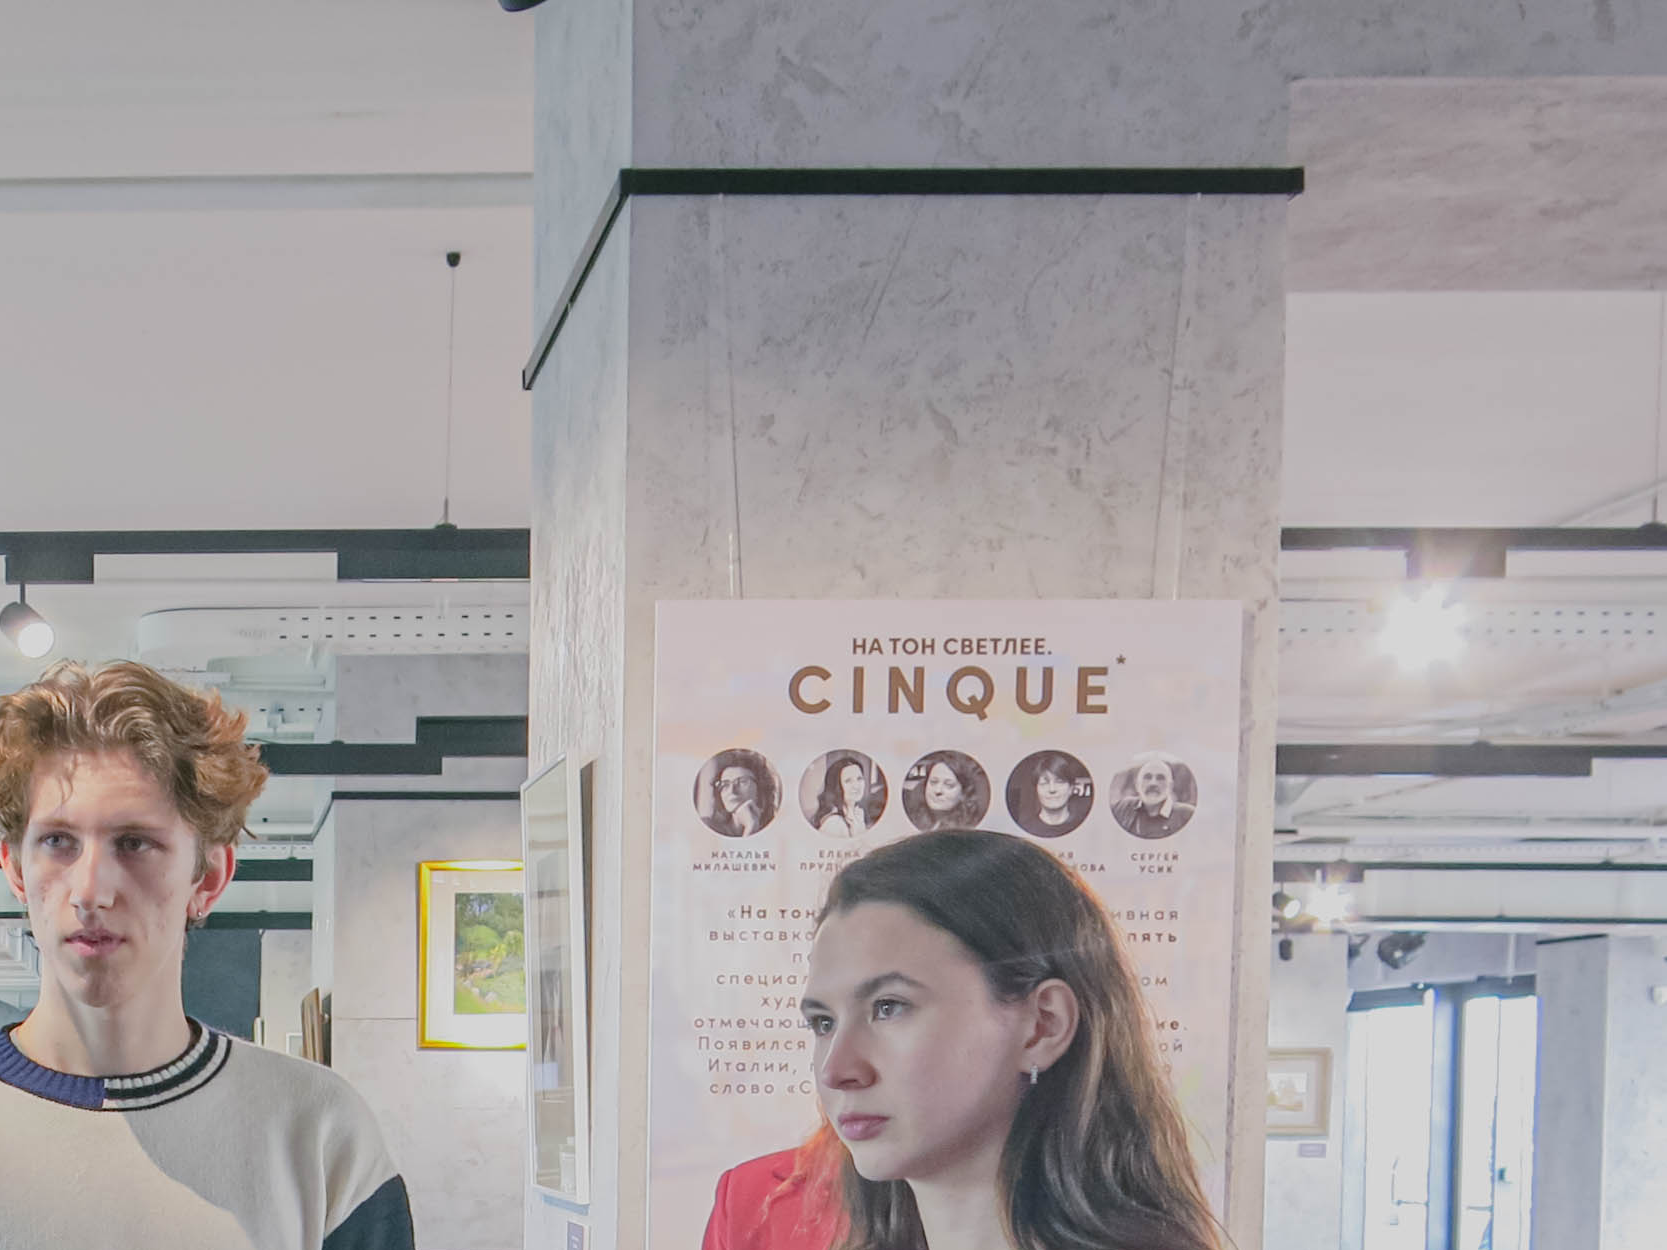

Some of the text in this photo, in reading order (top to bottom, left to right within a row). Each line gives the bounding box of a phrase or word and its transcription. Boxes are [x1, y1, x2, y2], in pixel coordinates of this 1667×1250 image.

[852, 637, 1053, 656] НА ТОН СВЕТЛЕЕ.
[787, 665, 1110, 722] CINQUE
[711, 850, 771, 859] НАТАЛЬЯ
[692, 862, 777, 872] МИЛАШЕВИЧ
[1139, 865, 1174, 874] УСИК
[779, 908, 816, 920] тон
[697, 1035, 807, 1051] Появился
[707, 1057, 798, 1075] Италии,
[709, 1082, 775, 1095] слово
